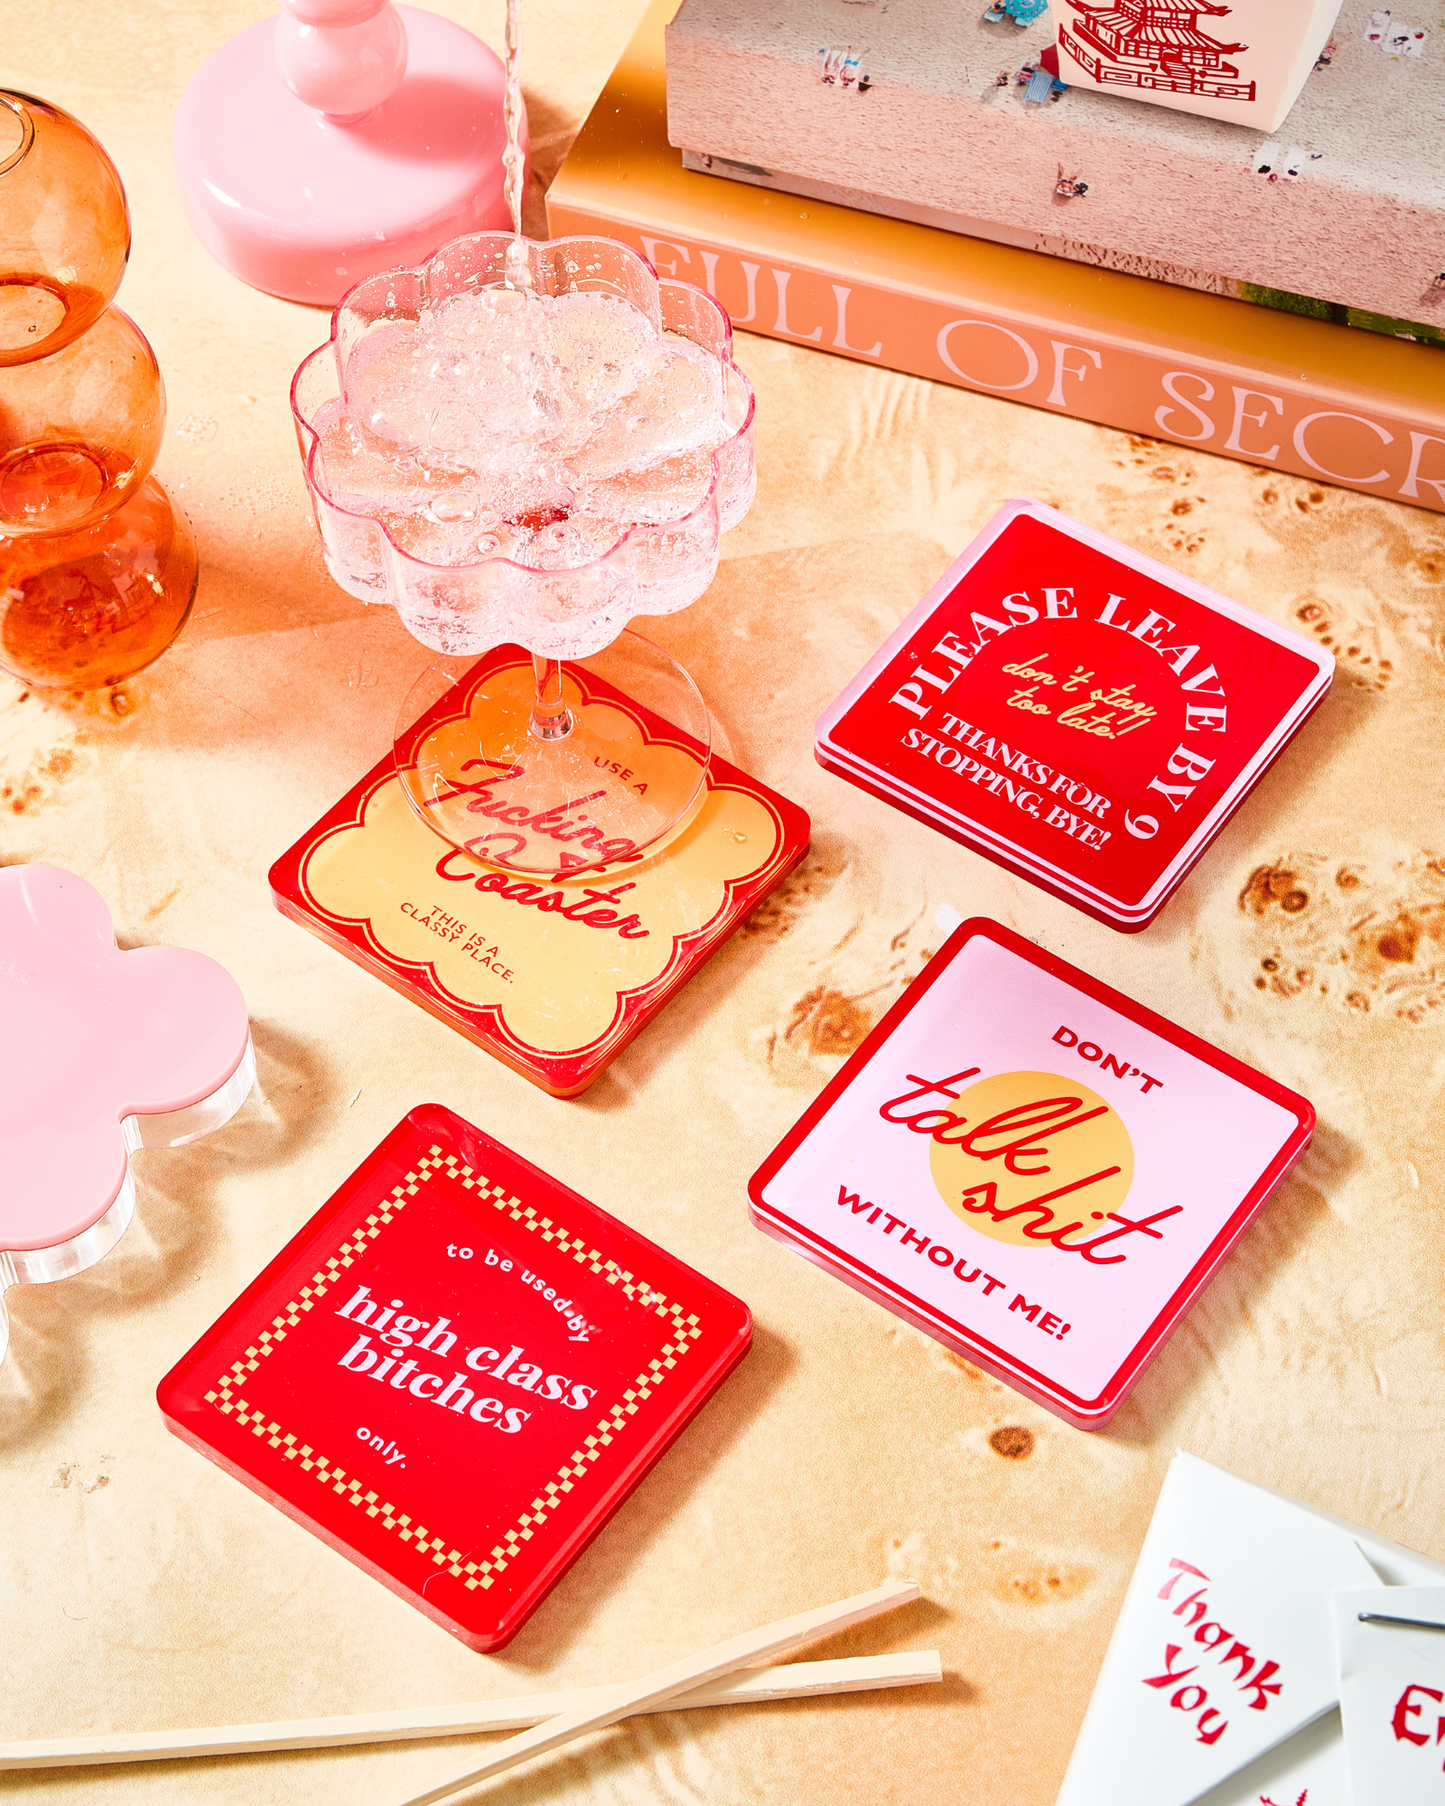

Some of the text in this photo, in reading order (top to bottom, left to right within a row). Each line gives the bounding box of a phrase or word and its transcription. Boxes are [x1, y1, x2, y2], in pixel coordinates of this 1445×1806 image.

[640, 235, 883, 358] FULL
[936, 318, 1103, 406] OF
[888, 587, 1227, 840] PLEASE LEAVE BY 9
[1002, 653, 1157, 725] don't stay
[1006, 686, 1151, 739] too late!
[593, 756, 649, 796] USE A
[900, 728, 1112, 850] STOPPING, BYE!
[938, 712, 1112, 819] THANKS FOR
[423, 759, 644, 883] Fucking
[432, 905, 499, 958] THIS IS A
[435, 832, 650, 939] Coaster
[400, 902, 515, 984] CLASSY PLACE.
[879, 1066, 1109, 1176] talk
[837, 1184, 1072, 1341] WITHOUT ME!
[962, 1165, 1184, 1265] shit
[446, 1243, 589, 1342] to be used by
[334, 1284, 598, 1410] high class
[337, 1333, 532, 1433] bitches
[356, 1427, 406, 1469] only.
[1157, 1557, 1283, 1711] Thank
[1140, 1643, 1229, 1746] You
